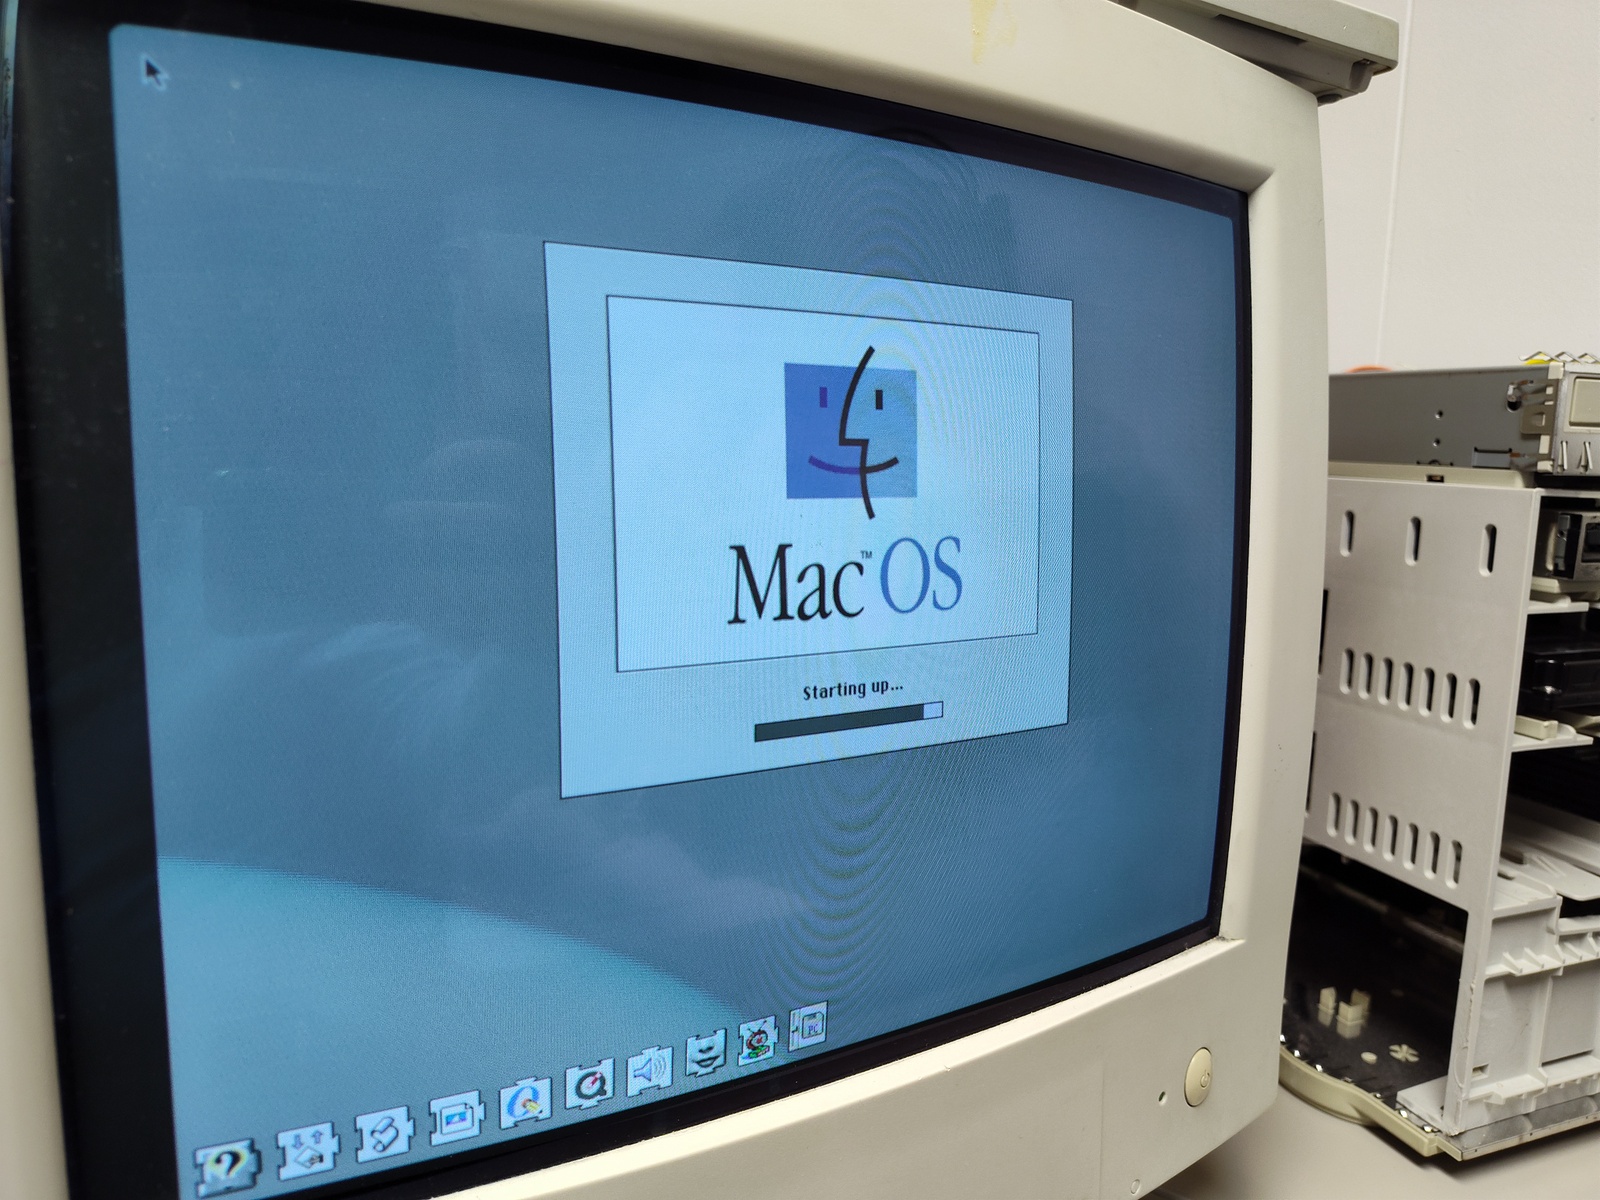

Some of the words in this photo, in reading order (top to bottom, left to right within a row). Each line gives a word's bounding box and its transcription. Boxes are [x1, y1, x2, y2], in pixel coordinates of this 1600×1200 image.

[880, 535, 963, 614] OS
[803, 682, 866, 701] Starting
[871, 680, 904, 695] up...
